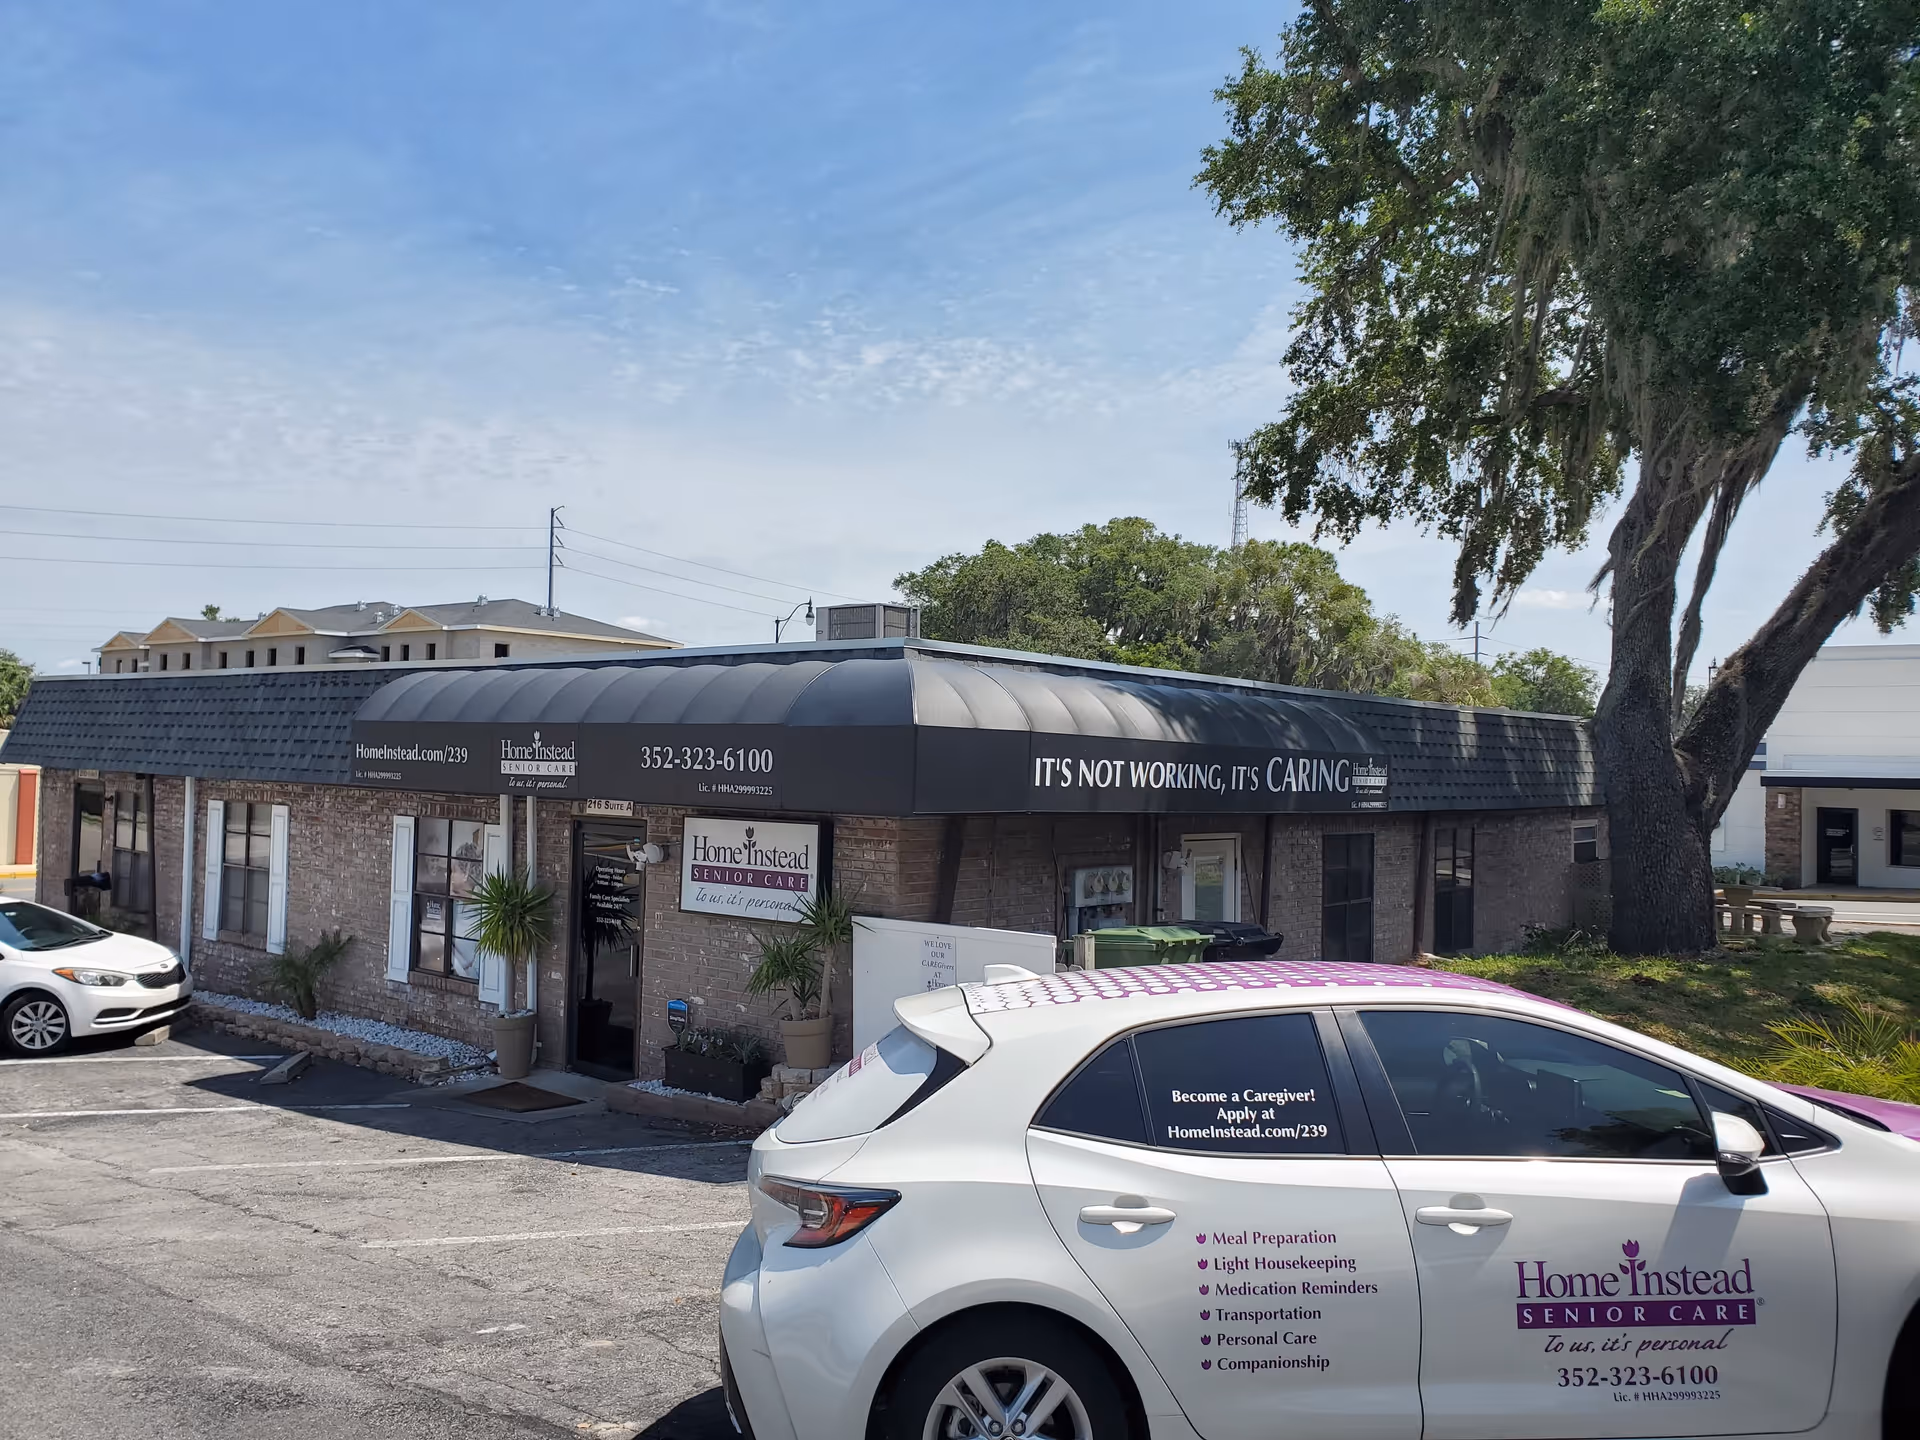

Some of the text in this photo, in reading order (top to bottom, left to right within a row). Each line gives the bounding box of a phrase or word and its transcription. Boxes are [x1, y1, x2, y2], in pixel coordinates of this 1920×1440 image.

[356, 743, 468, 764] HomeInstead.com/239
[501, 739, 575, 761] Home Instead
[502, 763, 573, 773] SENIOR CARE
[641, 746, 773, 773] 352-323-6100
[508, 776, 516, 787] To
[1034, 756, 1349, 796] IT'S NOT WORKING, IT'S CARING
[698, 782, 773, 796] Lic. # HHA299993225
[588, 799, 602, 810] 216
[626, 801, 633, 811] A
[692, 835, 810, 870] Home Instead
[595, 865, 614, 874] Operating
[693, 867, 806, 889] SENIOR CARE
[589, 893, 601, 901] Family
[695, 887, 709, 902] To
[710, 891, 724, 905] us,
[725, 890, 744, 906] it's
[924, 940, 952, 950] WE LOVE
[931, 950, 945, 959] OUR
[1171, 1088, 1316, 1105] Become a Caregiver!
[1217, 1106, 1275, 1123] Apply at
[1168, 1124, 1328, 1139] HomeInstead.com/239
[1212, 1230, 1337, 1248] Meal Preparation
[1214, 1255, 1357, 1274] Light Housekeeping
[1514, 1258, 1755, 1299] Home Instead
[1215, 1280, 1378, 1296] Medication Reminders
[1215, 1306, 1322, 1324] Transportation
[1523, 1304, 1748, 1324] SENIOR CARE
[1217, 1331, 1317, 1346] Personal Care
[1544, 1328, 1735, 1358] To us, it's personal
[1217, 1355, 1330, 1373] Companionship
[1557, 1365, 1718, 1387] 352-323-6100
[1613, 1390, 1721, 1402] Lic. # HHA299993225
